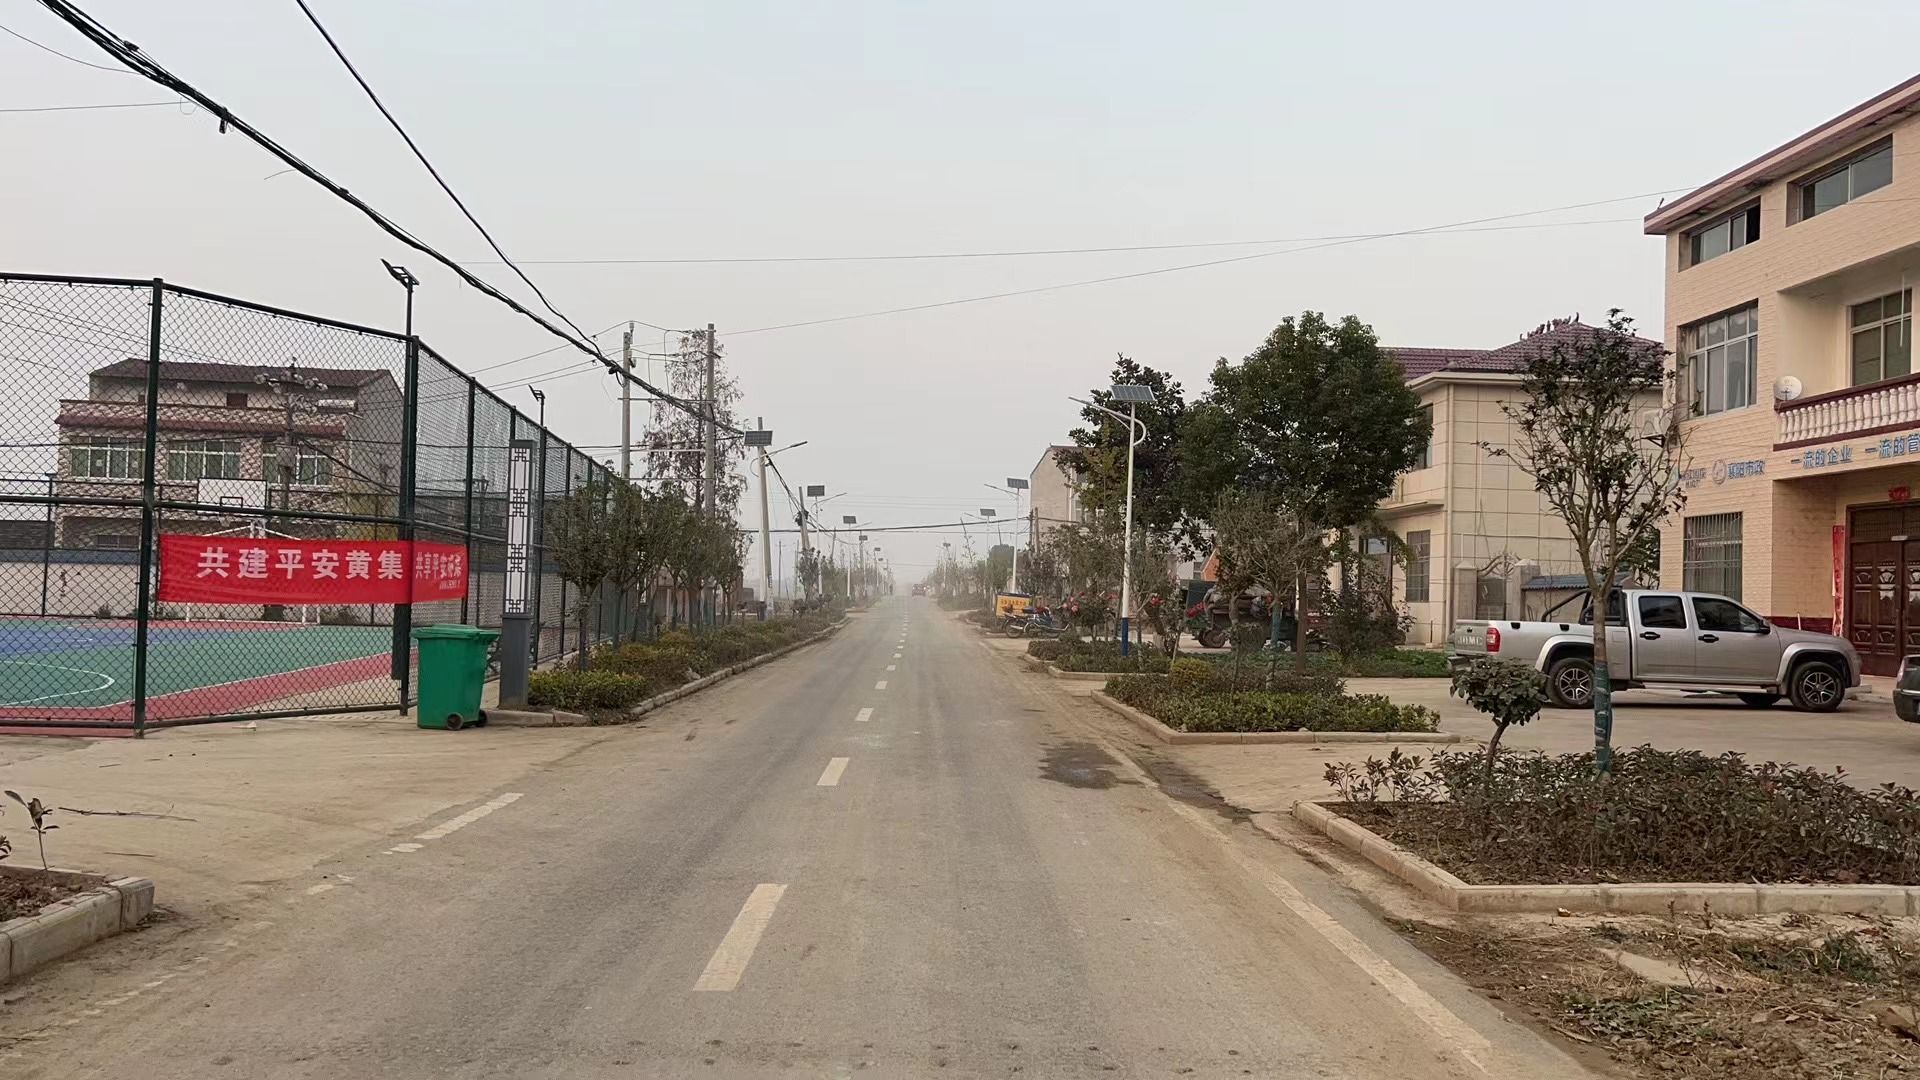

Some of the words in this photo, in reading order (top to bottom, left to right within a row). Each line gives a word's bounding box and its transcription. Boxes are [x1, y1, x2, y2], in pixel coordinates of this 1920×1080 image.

[196, 546, 403, 580] 共建平安黄集
